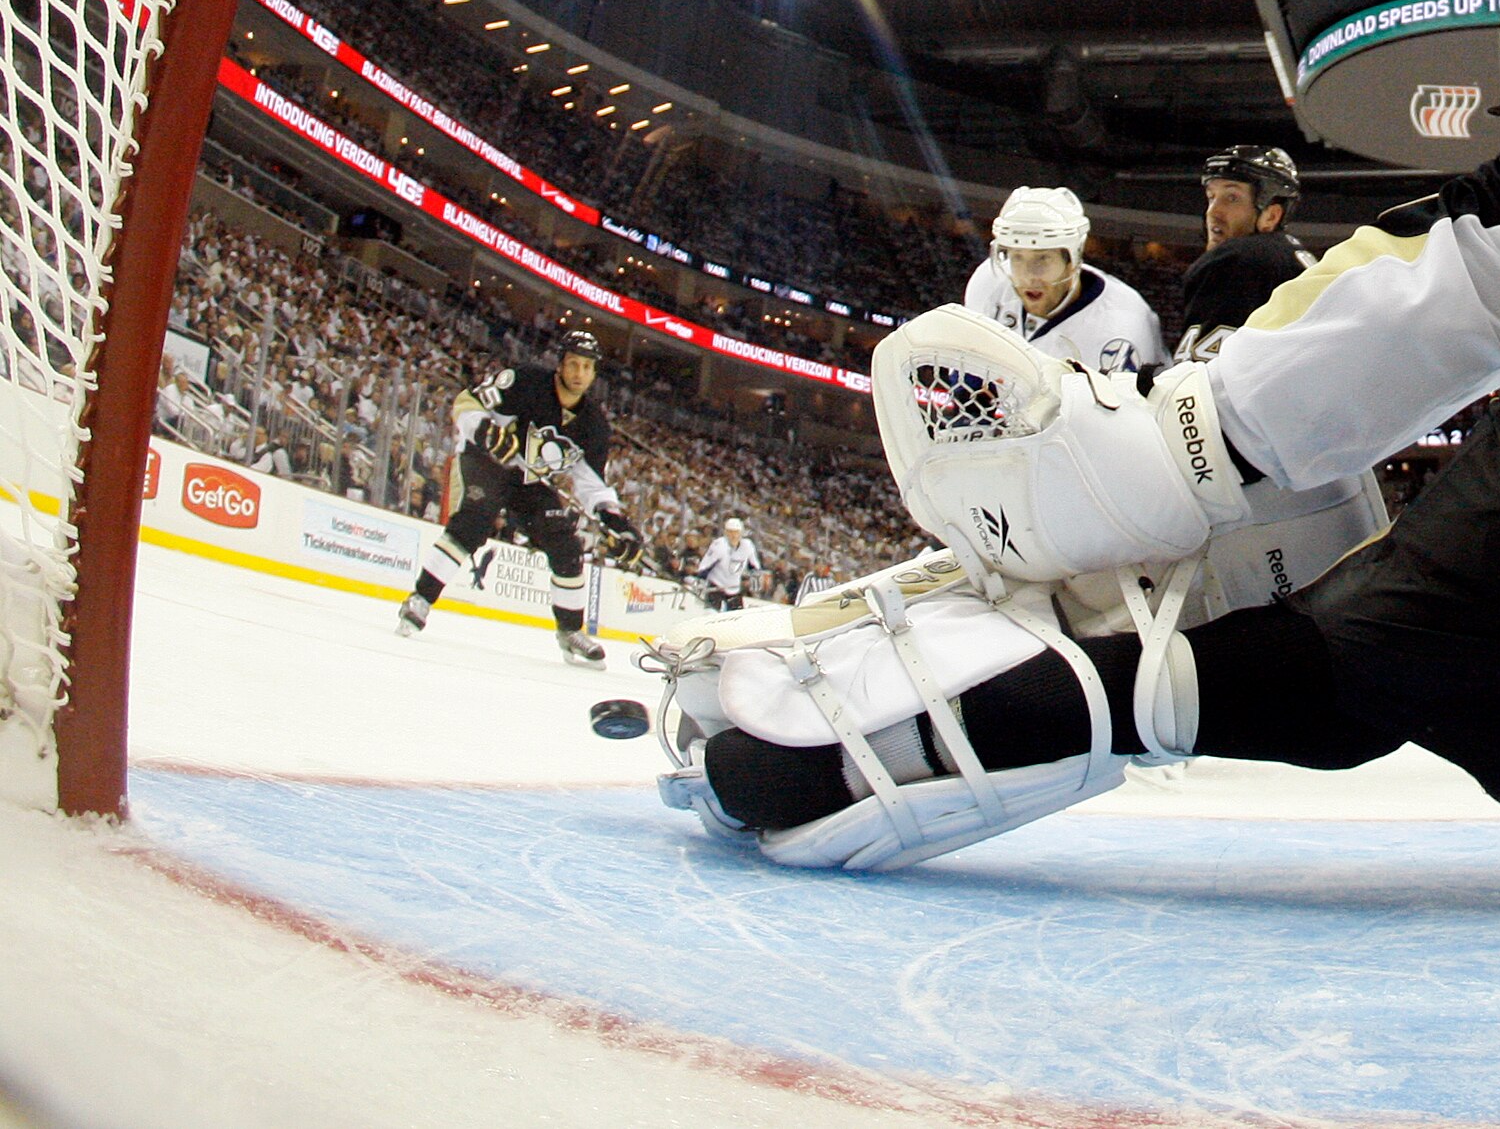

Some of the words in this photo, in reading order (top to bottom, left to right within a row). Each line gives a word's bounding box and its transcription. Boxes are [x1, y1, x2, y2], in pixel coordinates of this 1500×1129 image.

[1308, 15, 1377, 65] DOWNLOAD
[362, 60, 413, 108] BLAZINGLY
[480, 141, 524, 180] POWERFUL.
[254, 82, 334, 148] INTRODUCING
[335, 133, 385, 178] VERIZON
[442, 202, 498, 245] BLAZINGLY
[495, 233, 522, 261] FAST.
[570, 274, 625, 313] POWERFUL.
[712, 334, 785, 368] INTRODUCING
[784, 355, 832, 380] VERIZON
[1175, 395, 1214, 485] Reebok
[187, 477, 255, 517] GetGo
[331, 516, 389, 543] ticketmaster
[303, 532, 412, 571] Ticketmaster.com/nhl
[498, 546, 550, 571] AMERICA
[496, 564, 534, 585] EAGLE
[1265, 547, 1297, 598] Reeb
[495, 581, 551, 605] OUTFITTE
